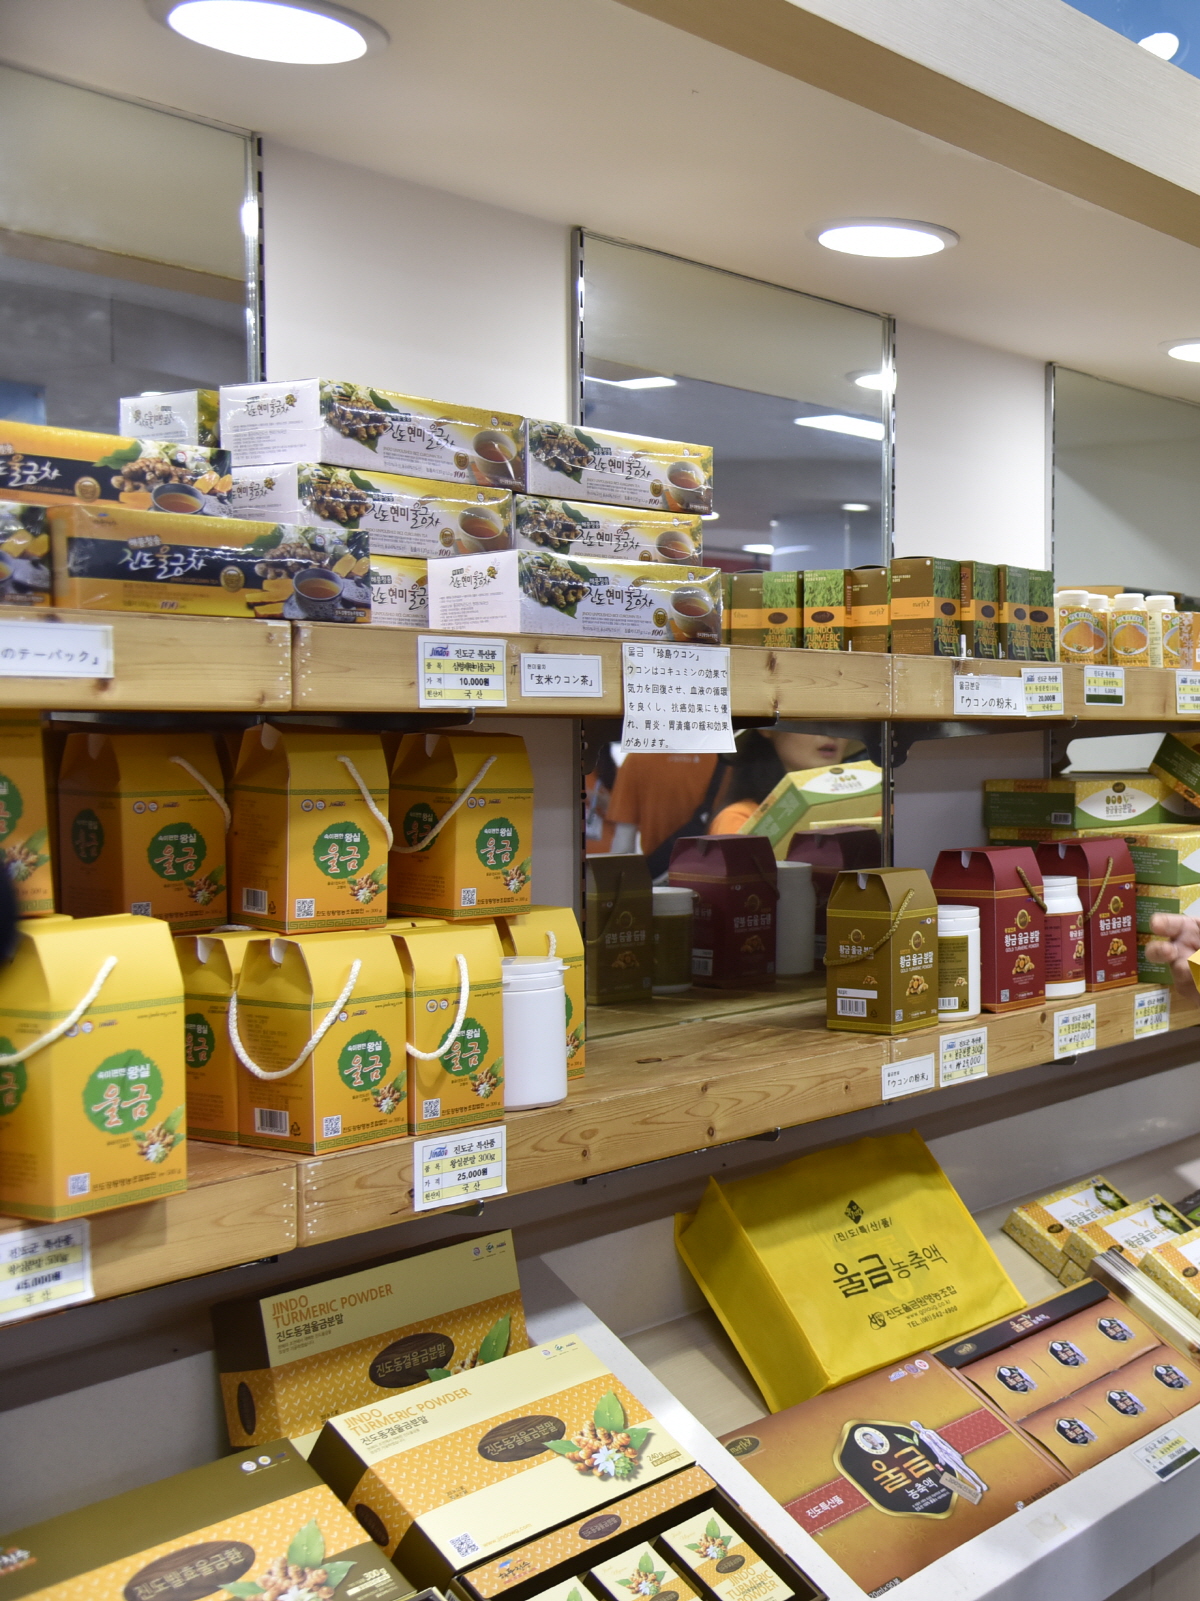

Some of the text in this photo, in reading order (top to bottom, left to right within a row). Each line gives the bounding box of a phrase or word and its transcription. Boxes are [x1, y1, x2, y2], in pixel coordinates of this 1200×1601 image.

[384, 421, 455, 450] 진도현미울금차
[588, 456, 651, 480] 진도현미울금차
[367, 502, 441, 529] 진도현미울금차
[577, 529, 640, 552] 진도현미울금차
[117, 545, 207, 579] 진도울금차
[371, 584, 428, 610] 진도현미울금
[584, 585, 655, 611] 진도현미울금차
[806, 633, 841, 642] TURMERIC
[808, 641, 839, 649] POWDER
[455, 649, 497, 660] 진도군 특산품
[459, 677, 490, 687] 10,000원
[530, 673, 593, 687] 「玄米ウコン茶」
[625, 737, 669, 749] があります。
[179, 833, 197, 844] 왕실
[344, 832, 361, 843] 왕실
[499, 826, 513, 837] 왕실
[153, 844, 198, 876] 울금
[319, 842, 361, 874] 울금
[480, 837, 513, 865] 울금
[1099, 915, 1132, 932] 황금 울금 분말
[1004, 930, 1040, 948] 황금 울금 분말
[899, 950, 934, 969] 황금 울금 분말
[465, 1028, 481, 1040] 왕실
[347, 1040, 382, 1052] 속이편한 왕실
[443, 1040, 481, 1072] 울금
[126, 1063, 152, 1080] 왕실
[344, 1054, 383, 1086] 울금
[91, 1083, 152, 1128] 울금
[453, 1138, 496, 1155] 진도군 특산품
[449, 1152, 496, 1169] 왕실분말 300g
[457, 1167, 488, 1182] 25,000원
[272, 1295, 309, 1317] JINDO
[273, 1283, 394, 1329] TURMERIC POWDER
[276, 1313, 344, 1343] 진도동결울금분말
[375, 1342, 447, 1378] 진도동결울금분말
[344, 1407, 383, 1428] JINDO
[349, 1387, 473, 1437] TURMERIC POWDER
[360, 1415, 429, 1446] 진도동결울금분말
[484, 1420, 559, 1456] 진도동결울금분말
[871, 1445, 937, 1494] 울금
[904, 1477, 939, 1501] 농축액
[805, 1494, 845, 1519] 진도특산품
[362, 1568, 379, 1581] 300
[725, 1569, 774, 1600] TURMERIC
[728, 1567, 756, 1587] JINDO
